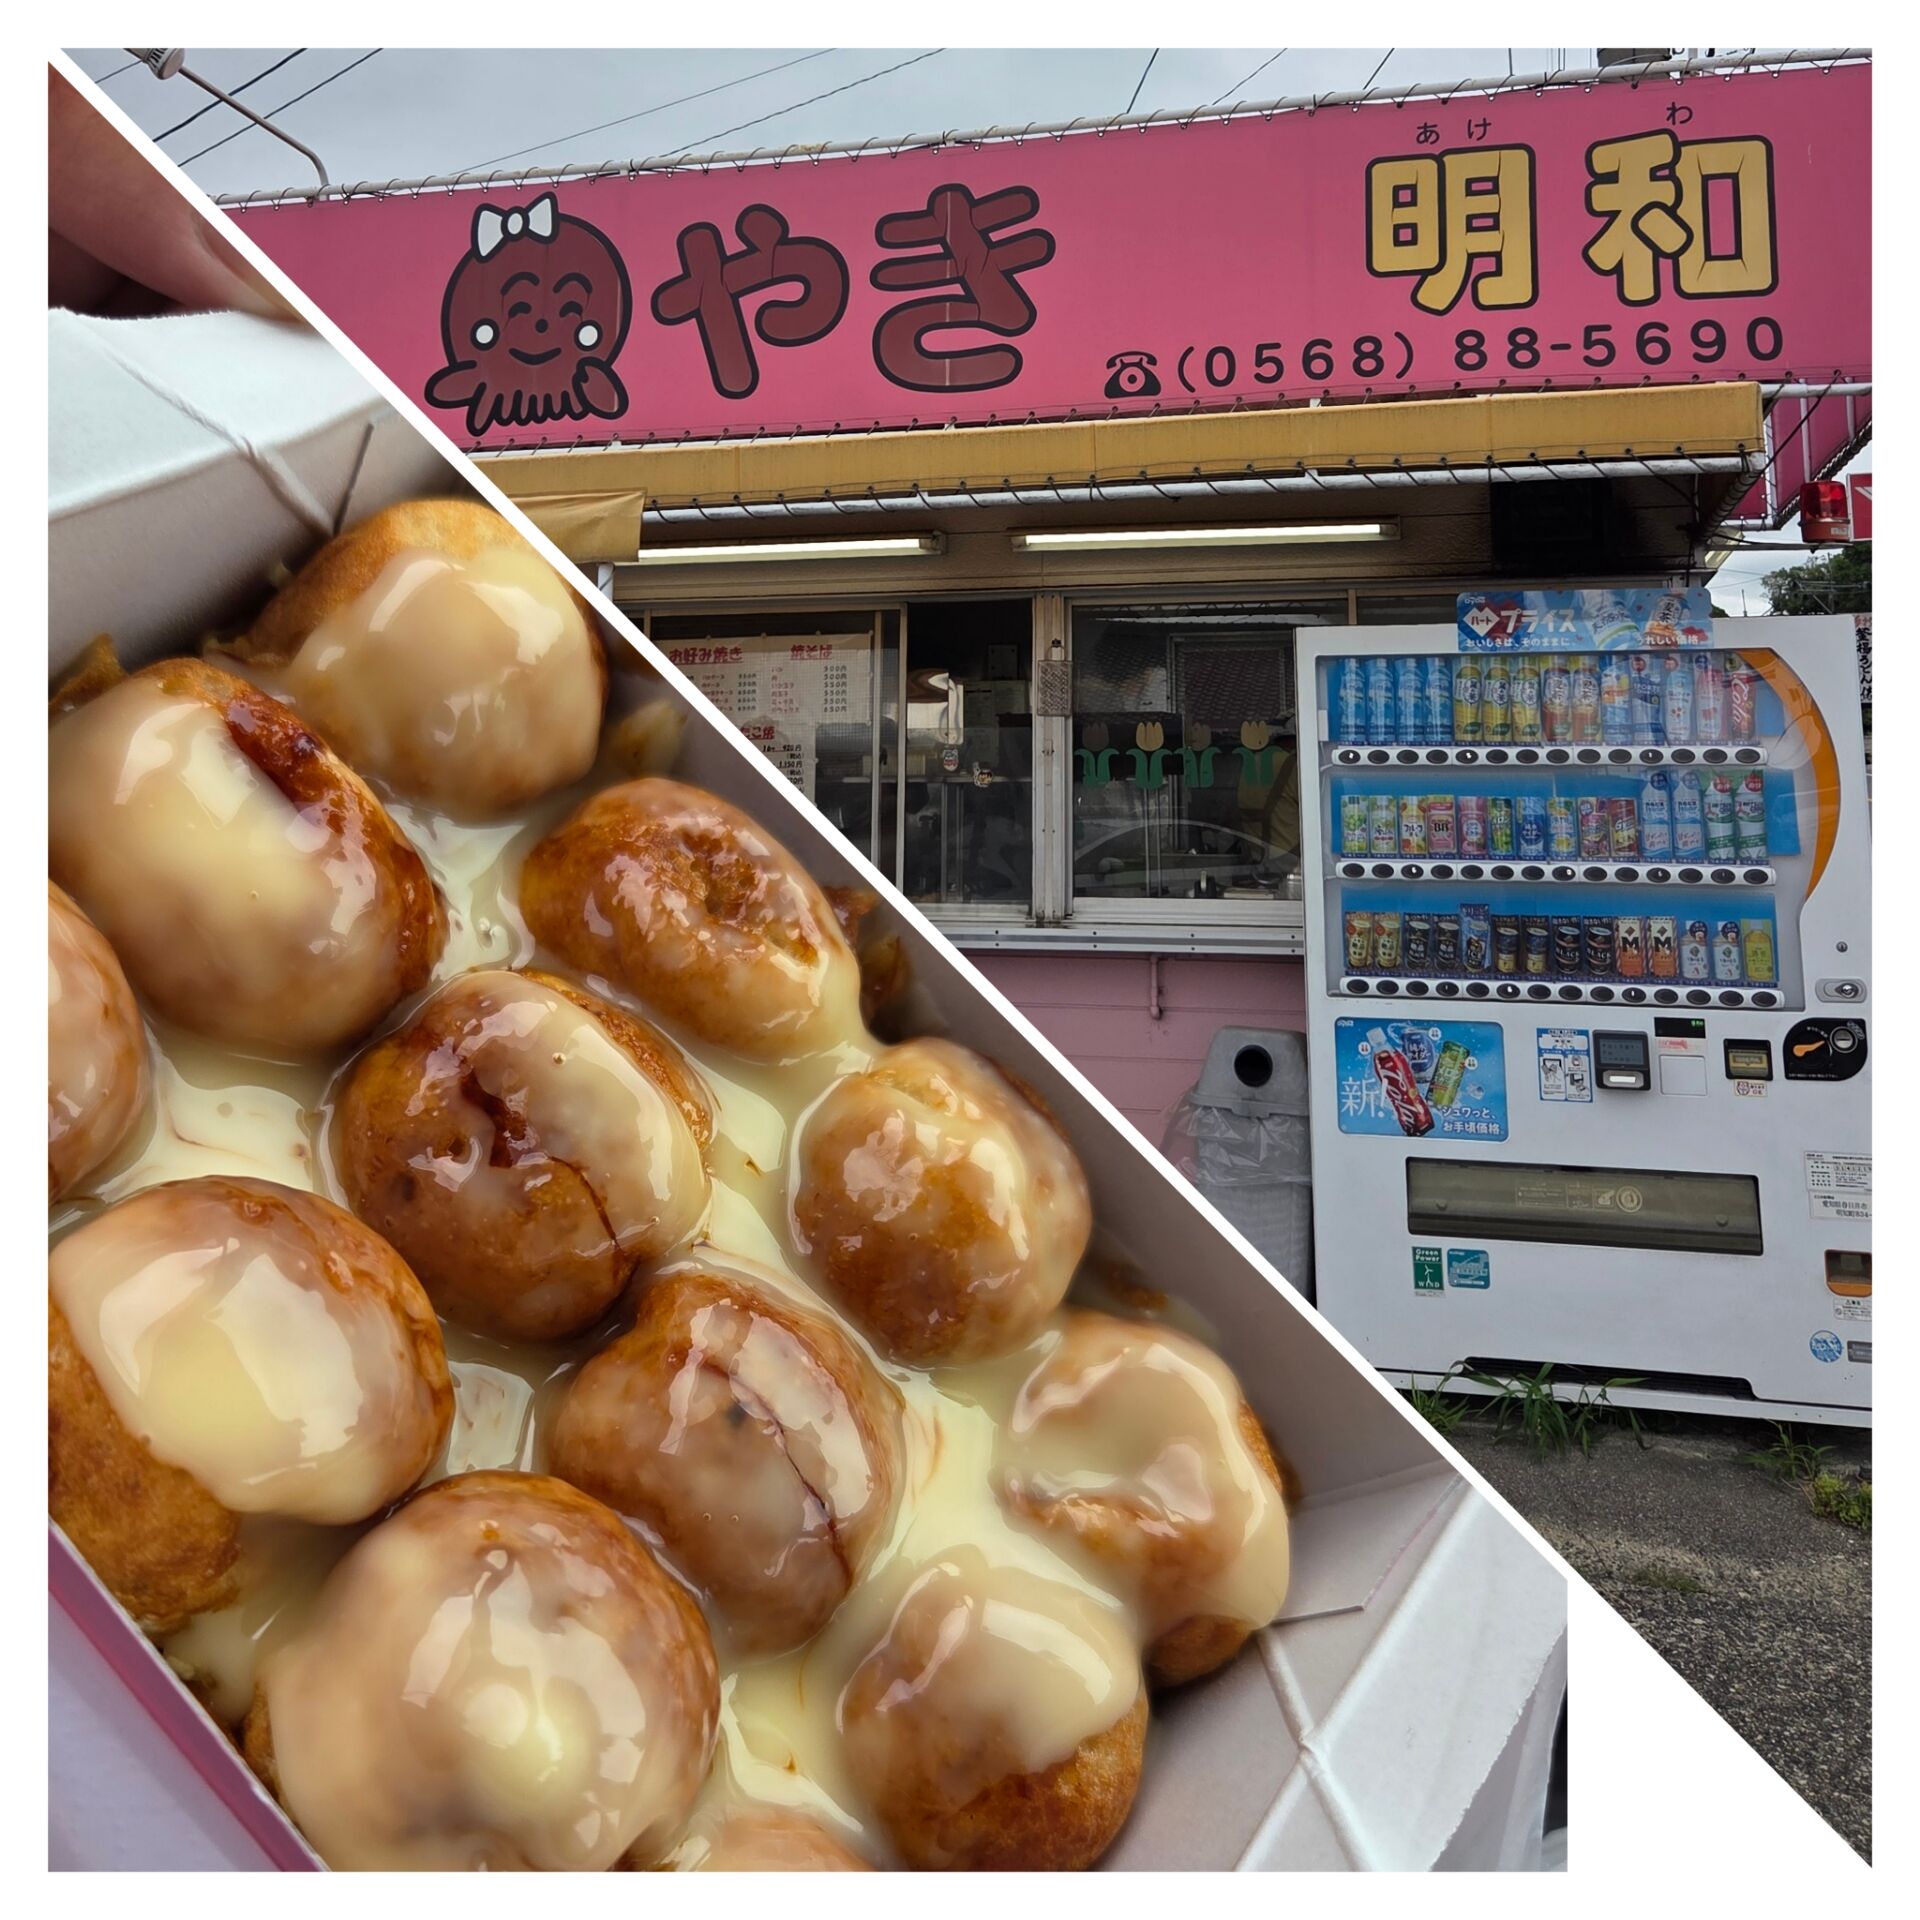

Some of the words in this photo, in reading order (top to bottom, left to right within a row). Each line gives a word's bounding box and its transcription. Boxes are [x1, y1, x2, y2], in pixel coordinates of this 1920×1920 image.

[1415, 117, 1493, 146] あけ
[1665, 101, 1695, 125] わ
[1364, 128, 1779, 316] 明和
[649, 182, 1057, 400] やき
[1177, 331, 1415, 393] (0568)
[1454, 316, 1785, 372] 88-5690
[1470, 616, 1493, 626] ハート
[1500, 608, 1577, 634] プライス
[1415, 1248, 1439, 1256] Green
